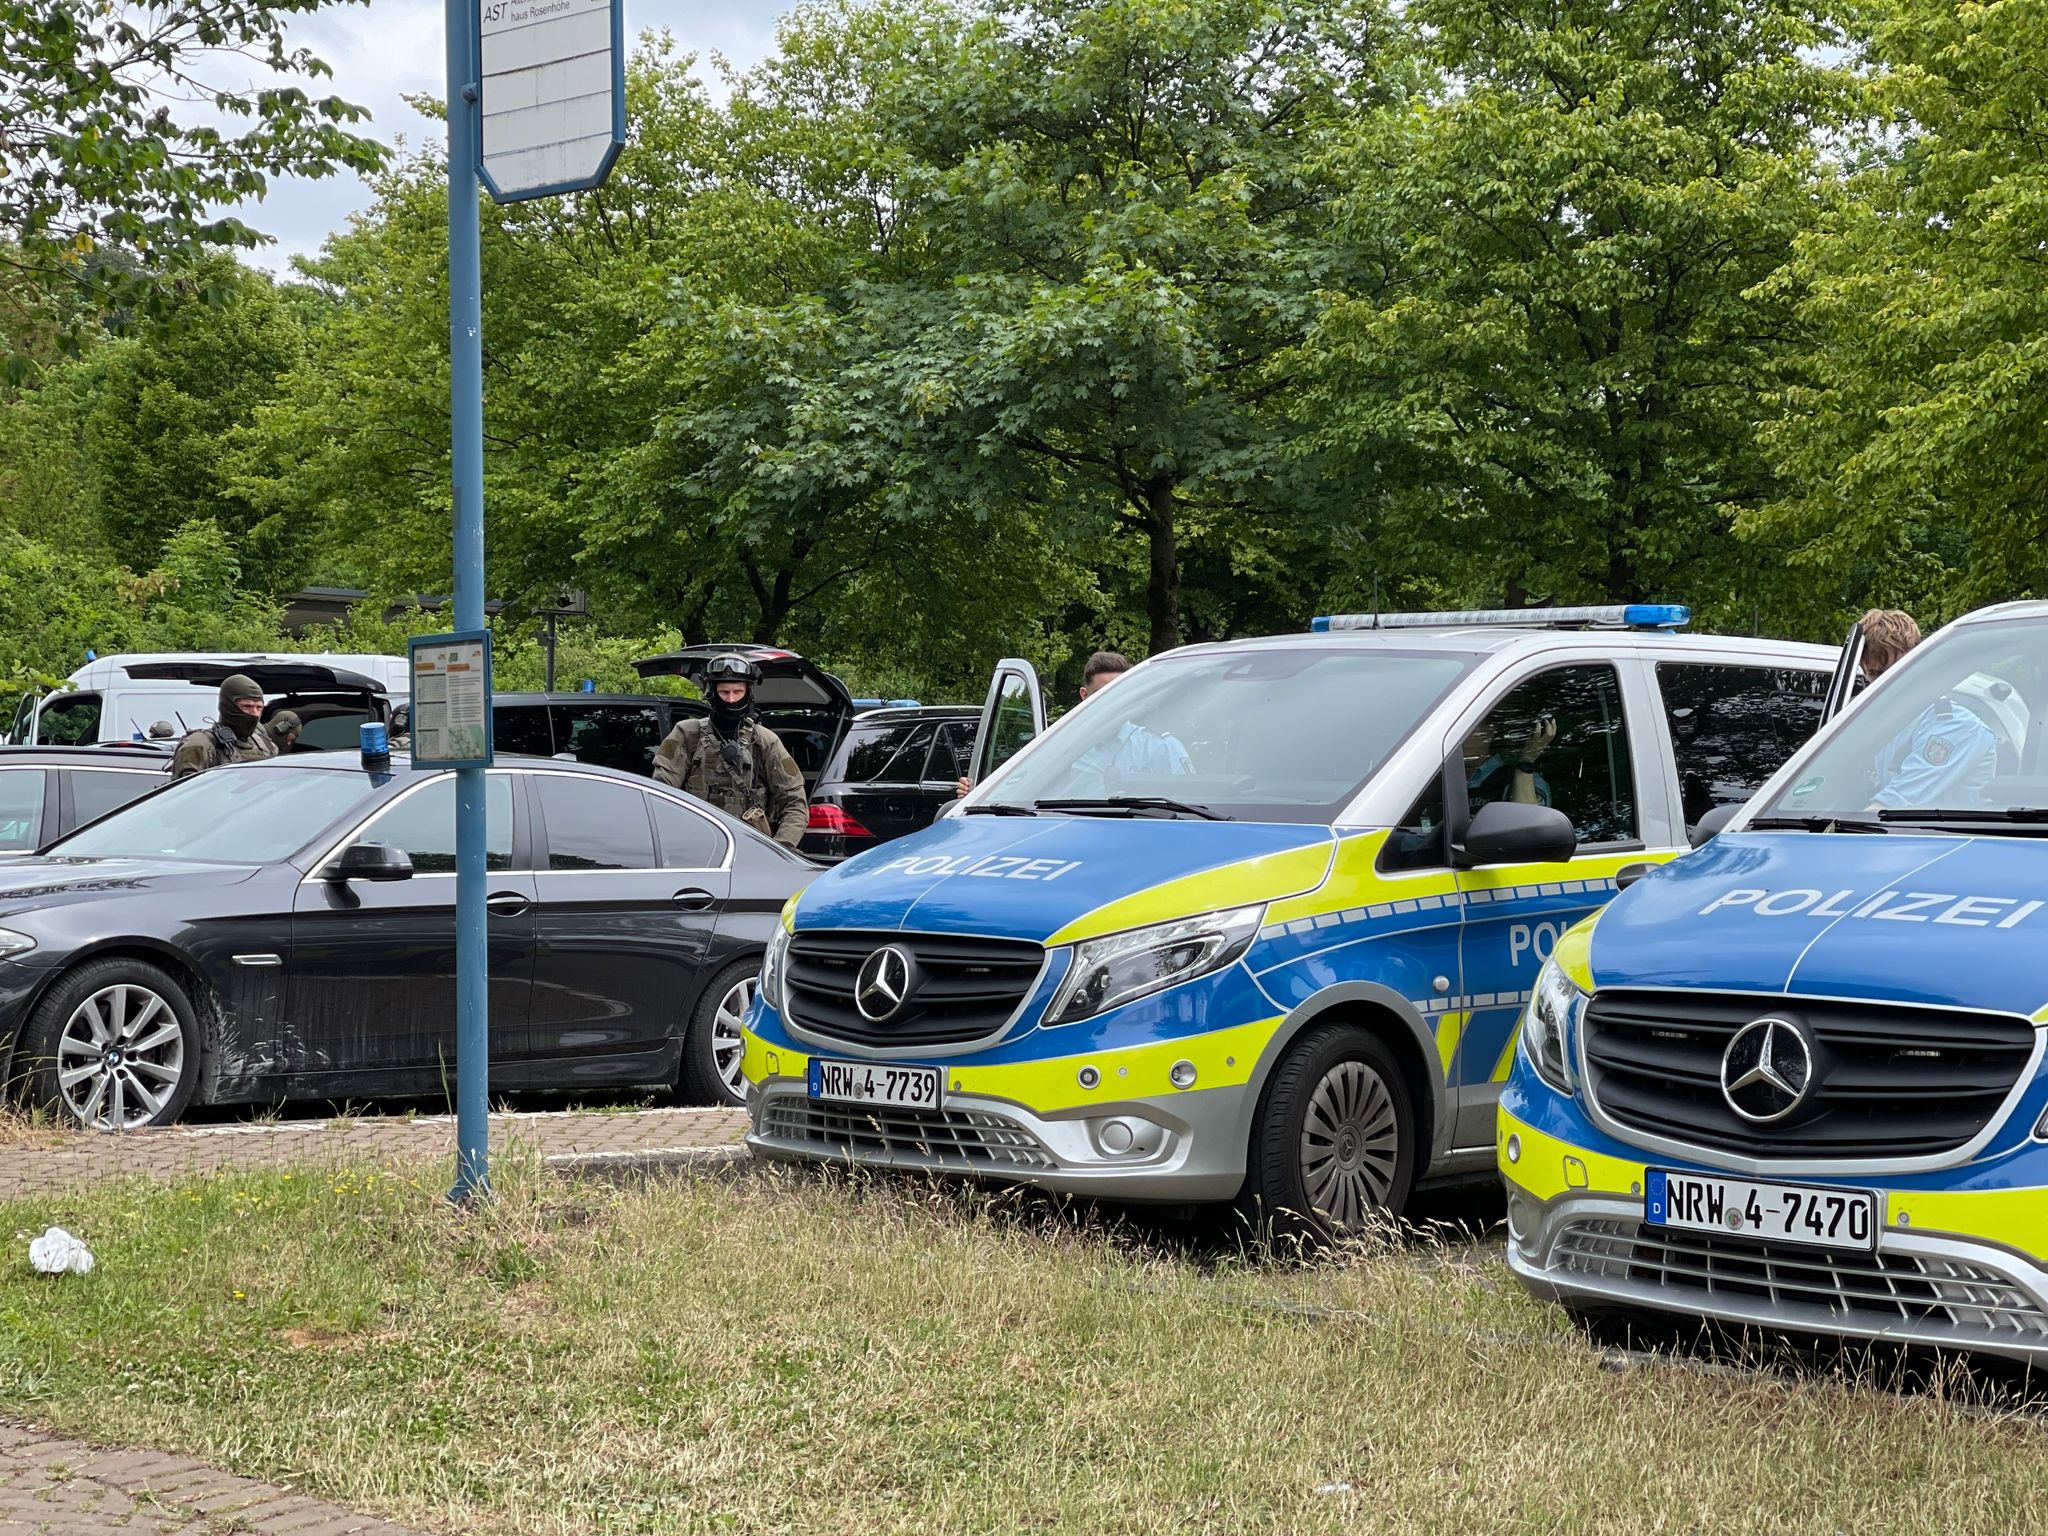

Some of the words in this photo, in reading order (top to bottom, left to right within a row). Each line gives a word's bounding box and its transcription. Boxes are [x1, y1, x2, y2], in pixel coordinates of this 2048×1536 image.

[483, 2, 508, 23] AST
[510, 11, 528, 22] haus
[529, 1, 570, 17] Rosenhöhe
[871, 856, 1083, 881] POLIZEI
[1697, 889, 2046, 928] POLIZEI
[820, 1065, 853, 1096] NRW
[864, 1069, 935, 1103] 4-7739
[1653, 1203, 1661, 1214] D
[1667, 1179, 1724, 1225] NRW
[1745, 1189, 1868, 1240] 4-7470
